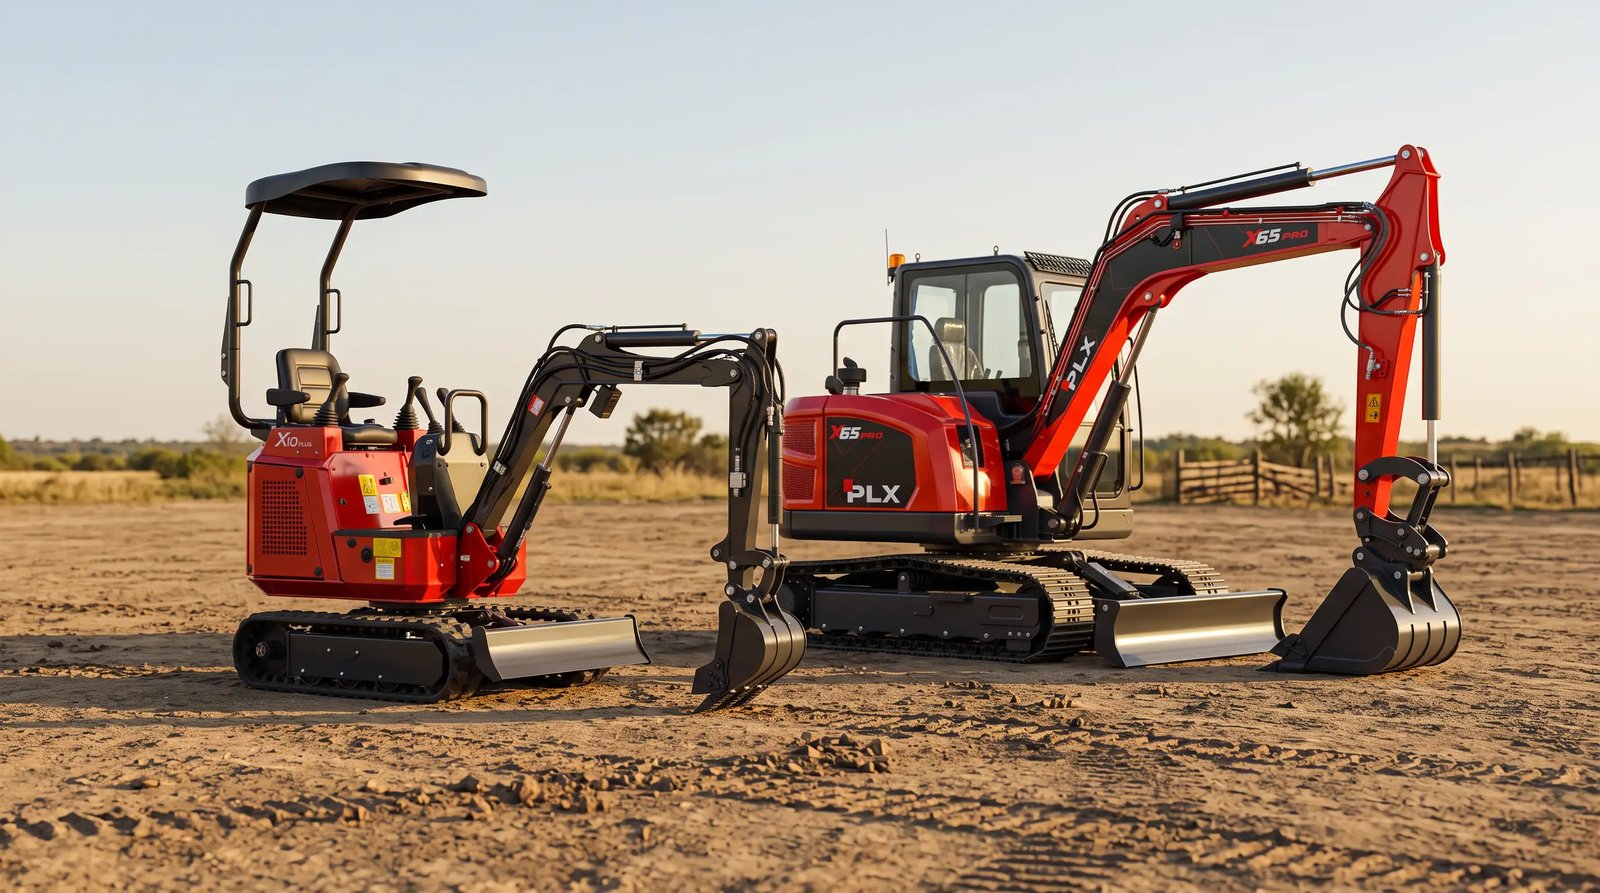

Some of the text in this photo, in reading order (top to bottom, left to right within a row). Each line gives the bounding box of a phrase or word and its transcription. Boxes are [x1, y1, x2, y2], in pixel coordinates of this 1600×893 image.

[1242, 228, 1309, 248] X65 PRO
[1061, 335, 1096, 391] PLX
[274, 431, 298, 448] X10
[830, 424, 884, 440] X65 PRO
[843, 479, 900, 503] PLX
